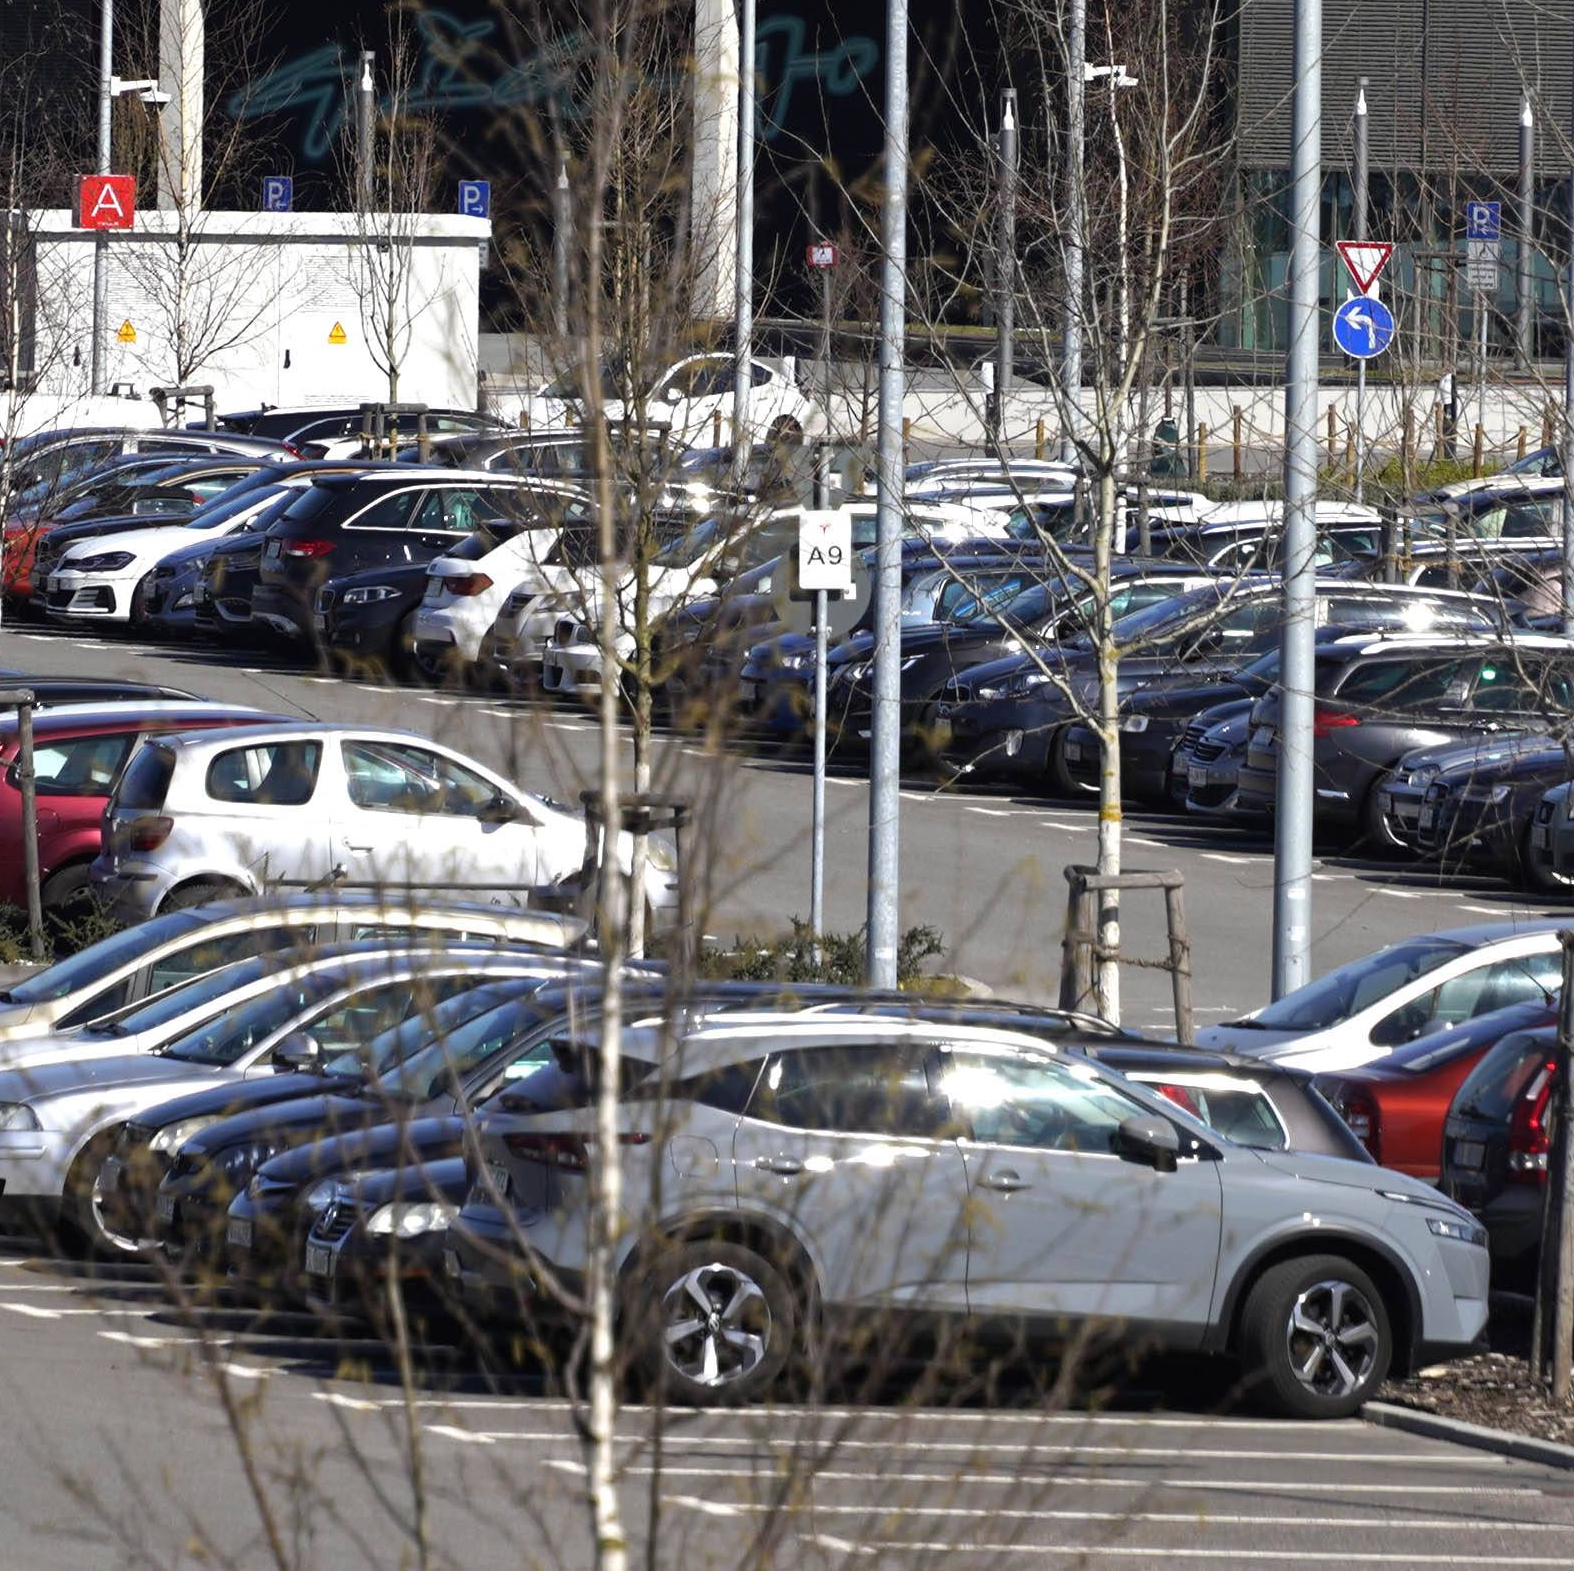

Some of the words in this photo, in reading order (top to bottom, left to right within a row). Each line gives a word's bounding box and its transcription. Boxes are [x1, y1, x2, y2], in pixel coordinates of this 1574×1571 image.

[91, 182, 124, 217] A
[268, 182, 283, 211] P
[464, 186, 481, 213] P
[1472, 206, 1490, 234] P
[807, 545, 843, 566] A9
